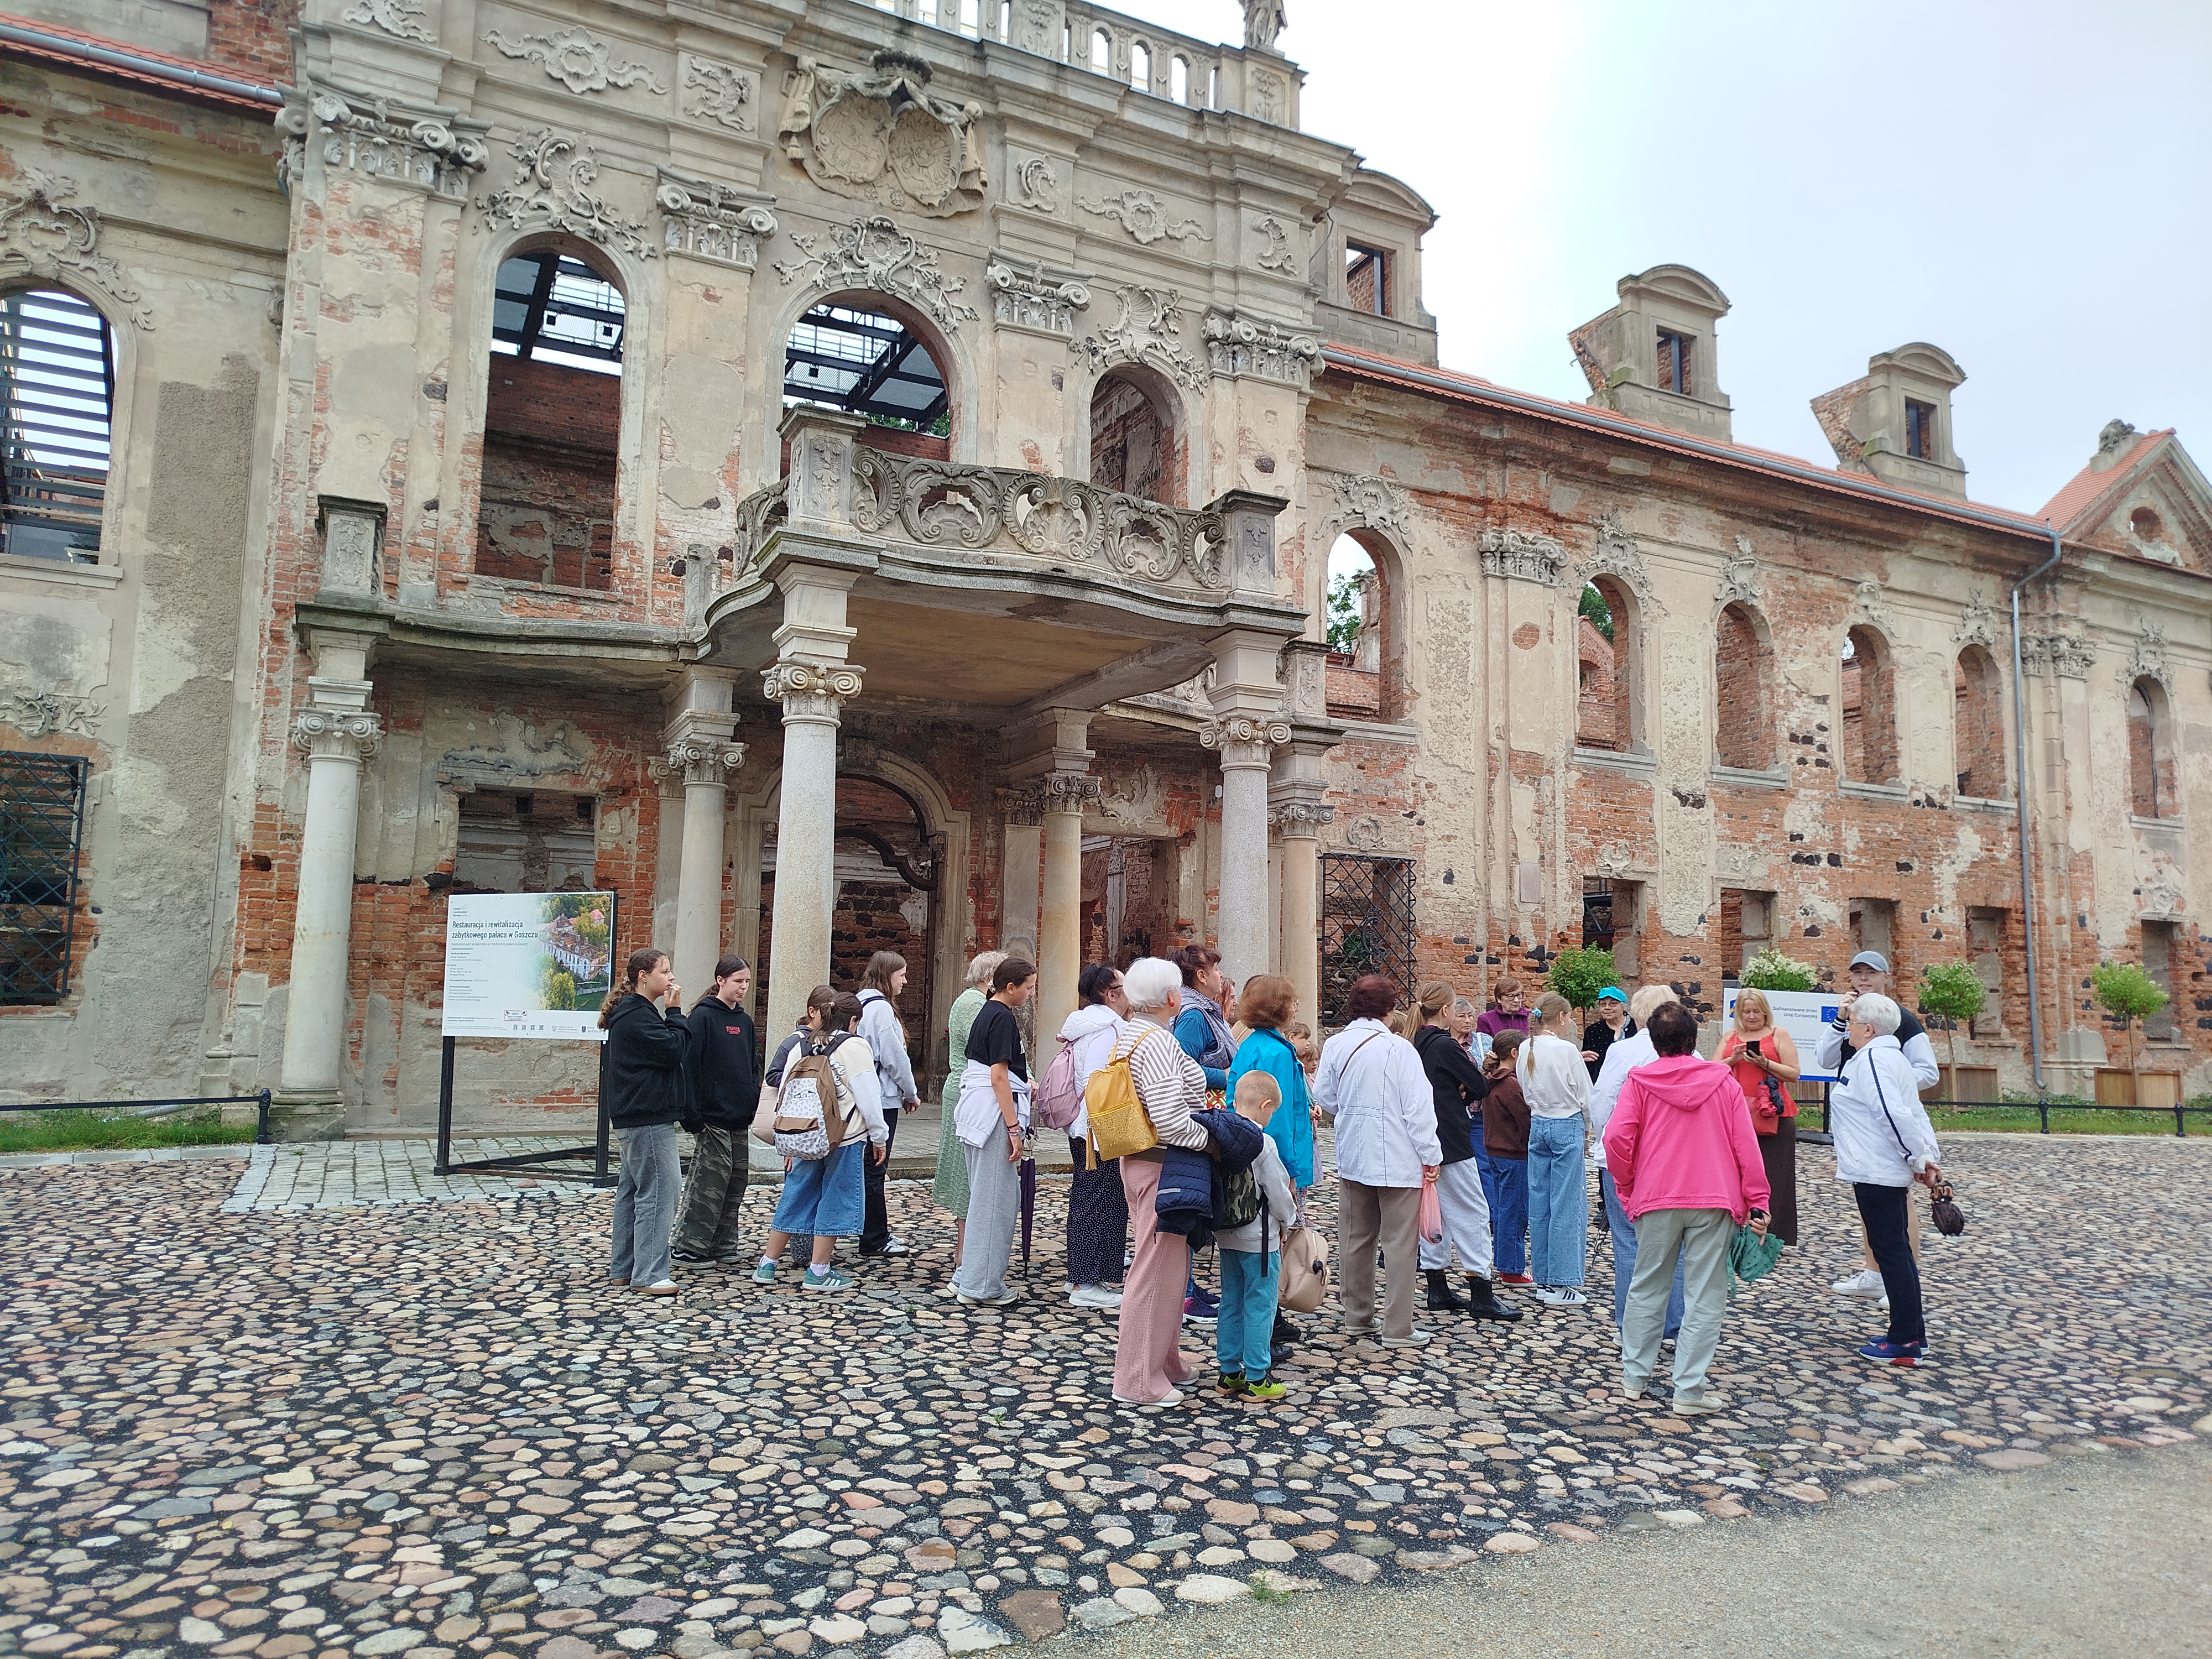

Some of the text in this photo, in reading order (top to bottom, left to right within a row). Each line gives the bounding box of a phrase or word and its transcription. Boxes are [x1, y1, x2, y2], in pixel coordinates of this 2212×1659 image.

[452, 920, 484, 930] Restauracja
[488, 920, 523, 930] rewitalizacja
[452, 931, 487, 940] zabytkowego
[488, 931, 507, 940] pałacu
